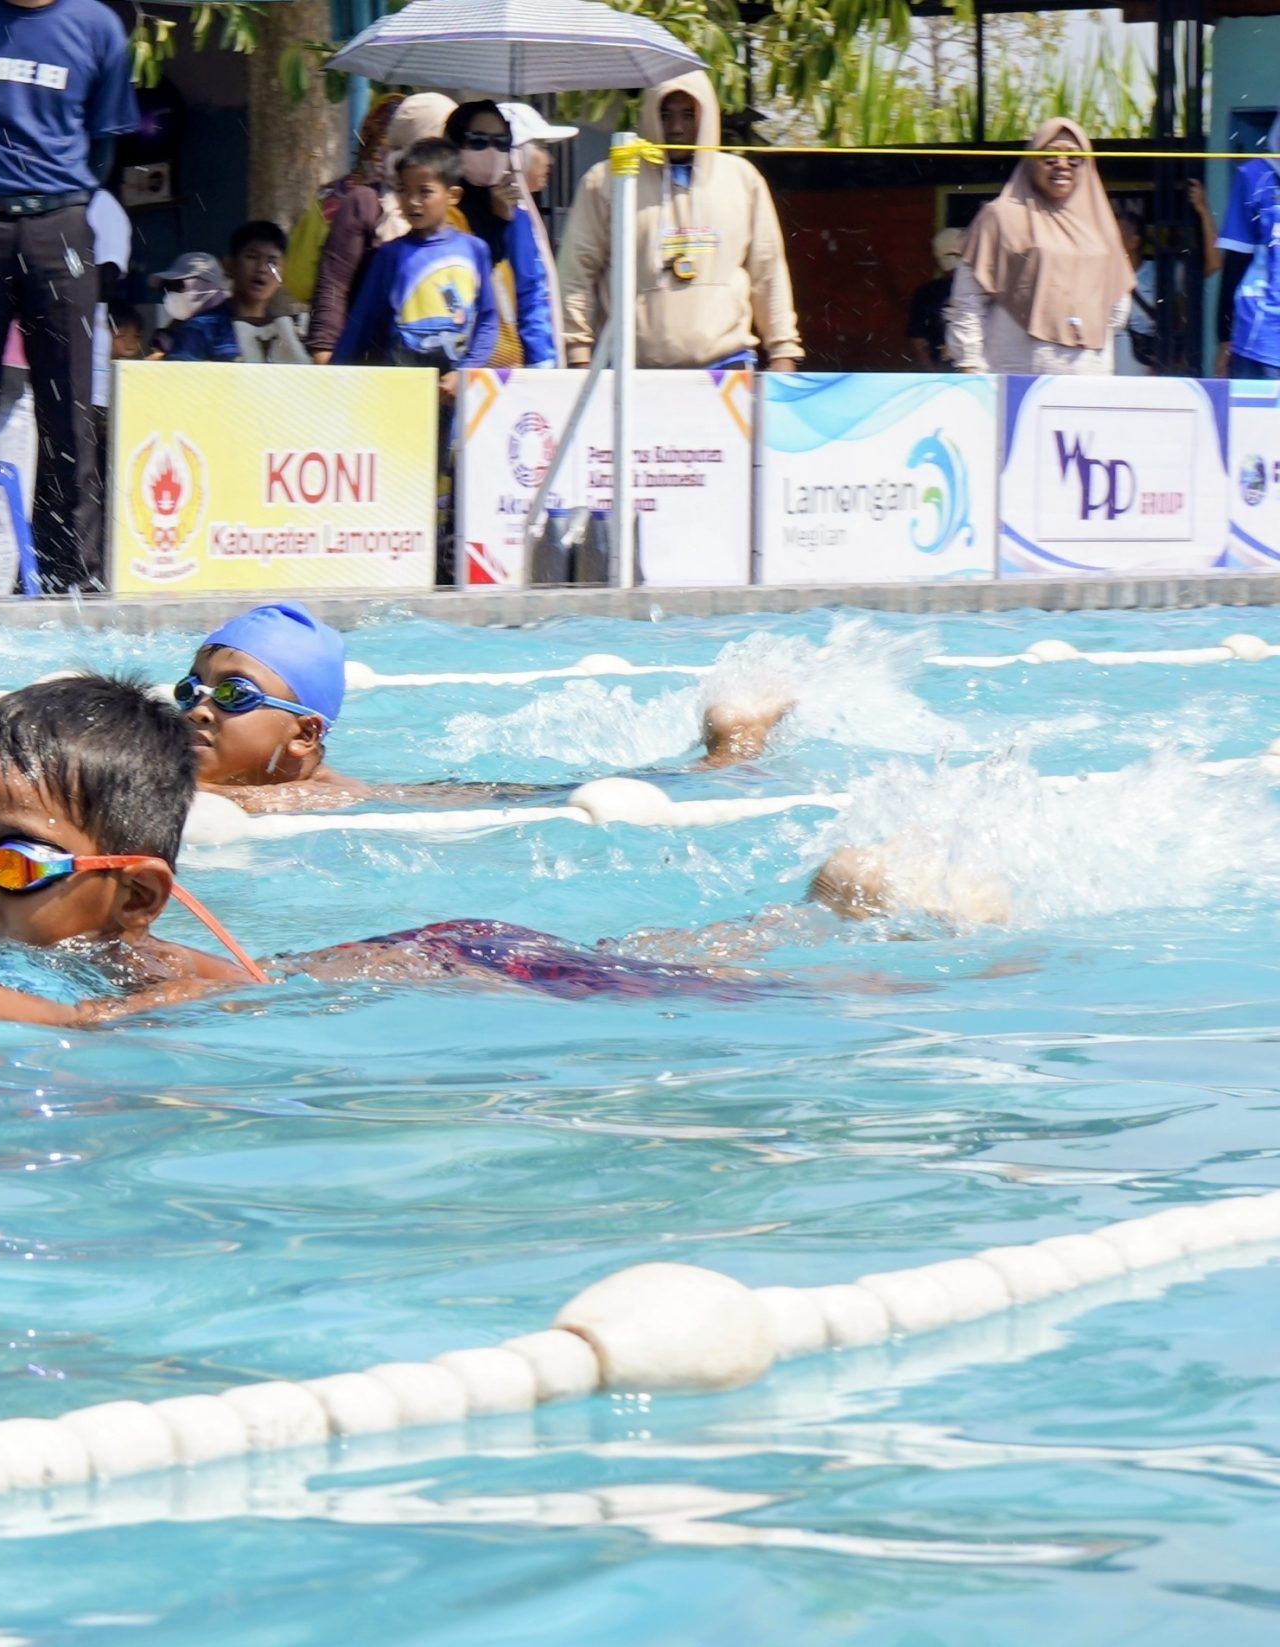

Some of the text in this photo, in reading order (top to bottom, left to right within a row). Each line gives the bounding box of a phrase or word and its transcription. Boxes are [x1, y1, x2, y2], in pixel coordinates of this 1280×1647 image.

[265, 451, 378, 504] KONI
[782, 477, 917, 521] Lamongan
[210, 523, 425, 565] Kabupaten Lamongan
